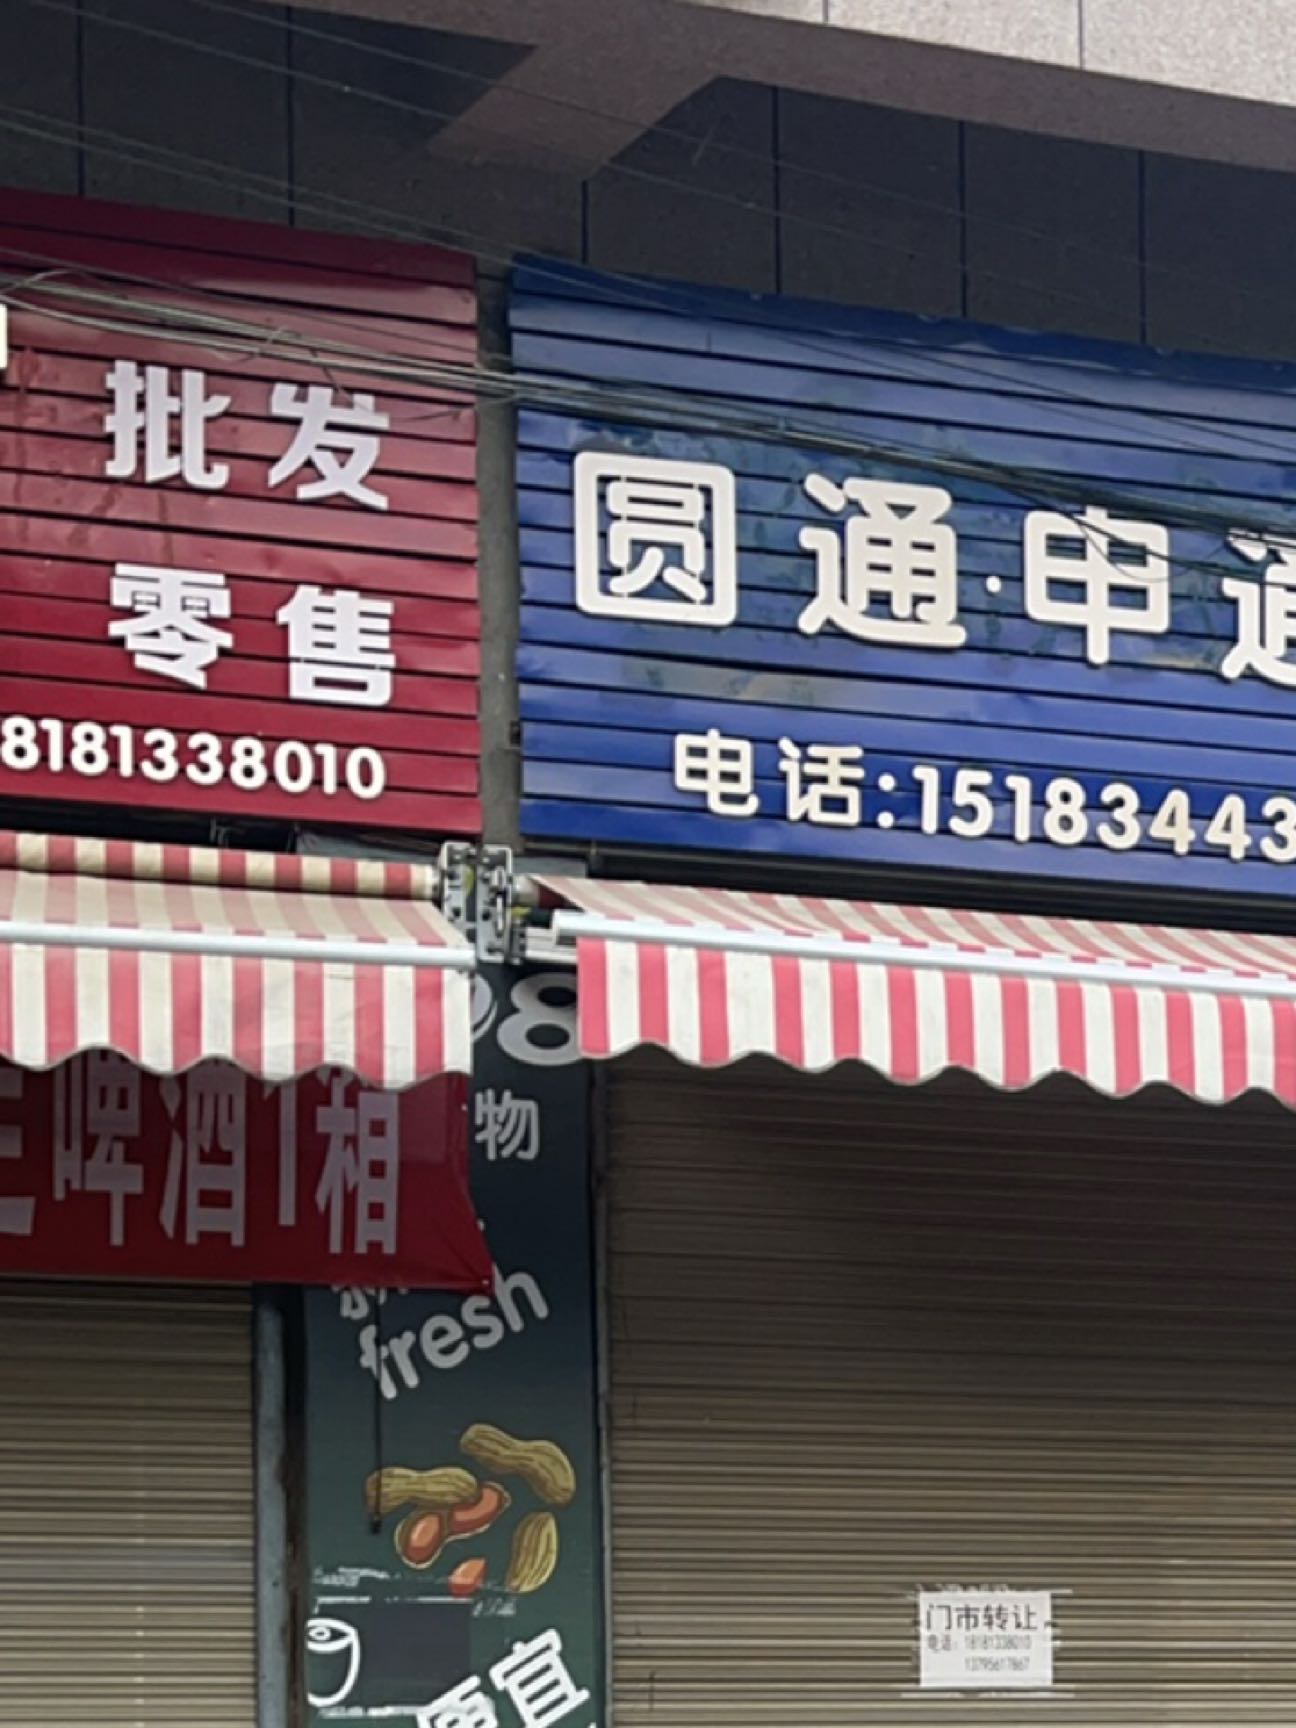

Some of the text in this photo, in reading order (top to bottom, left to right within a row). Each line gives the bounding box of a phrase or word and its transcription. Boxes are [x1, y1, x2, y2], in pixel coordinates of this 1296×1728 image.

[105, 359, 390, 511] 批发
[107, 563, 396, 706] 零售
[1, 715, 386, 799] 8181338010
[475, 1088, 540, 1161] 物
[359, 1263, 549, 1400] fresh
[927, 1604, 1038, 1631] 门市转让
